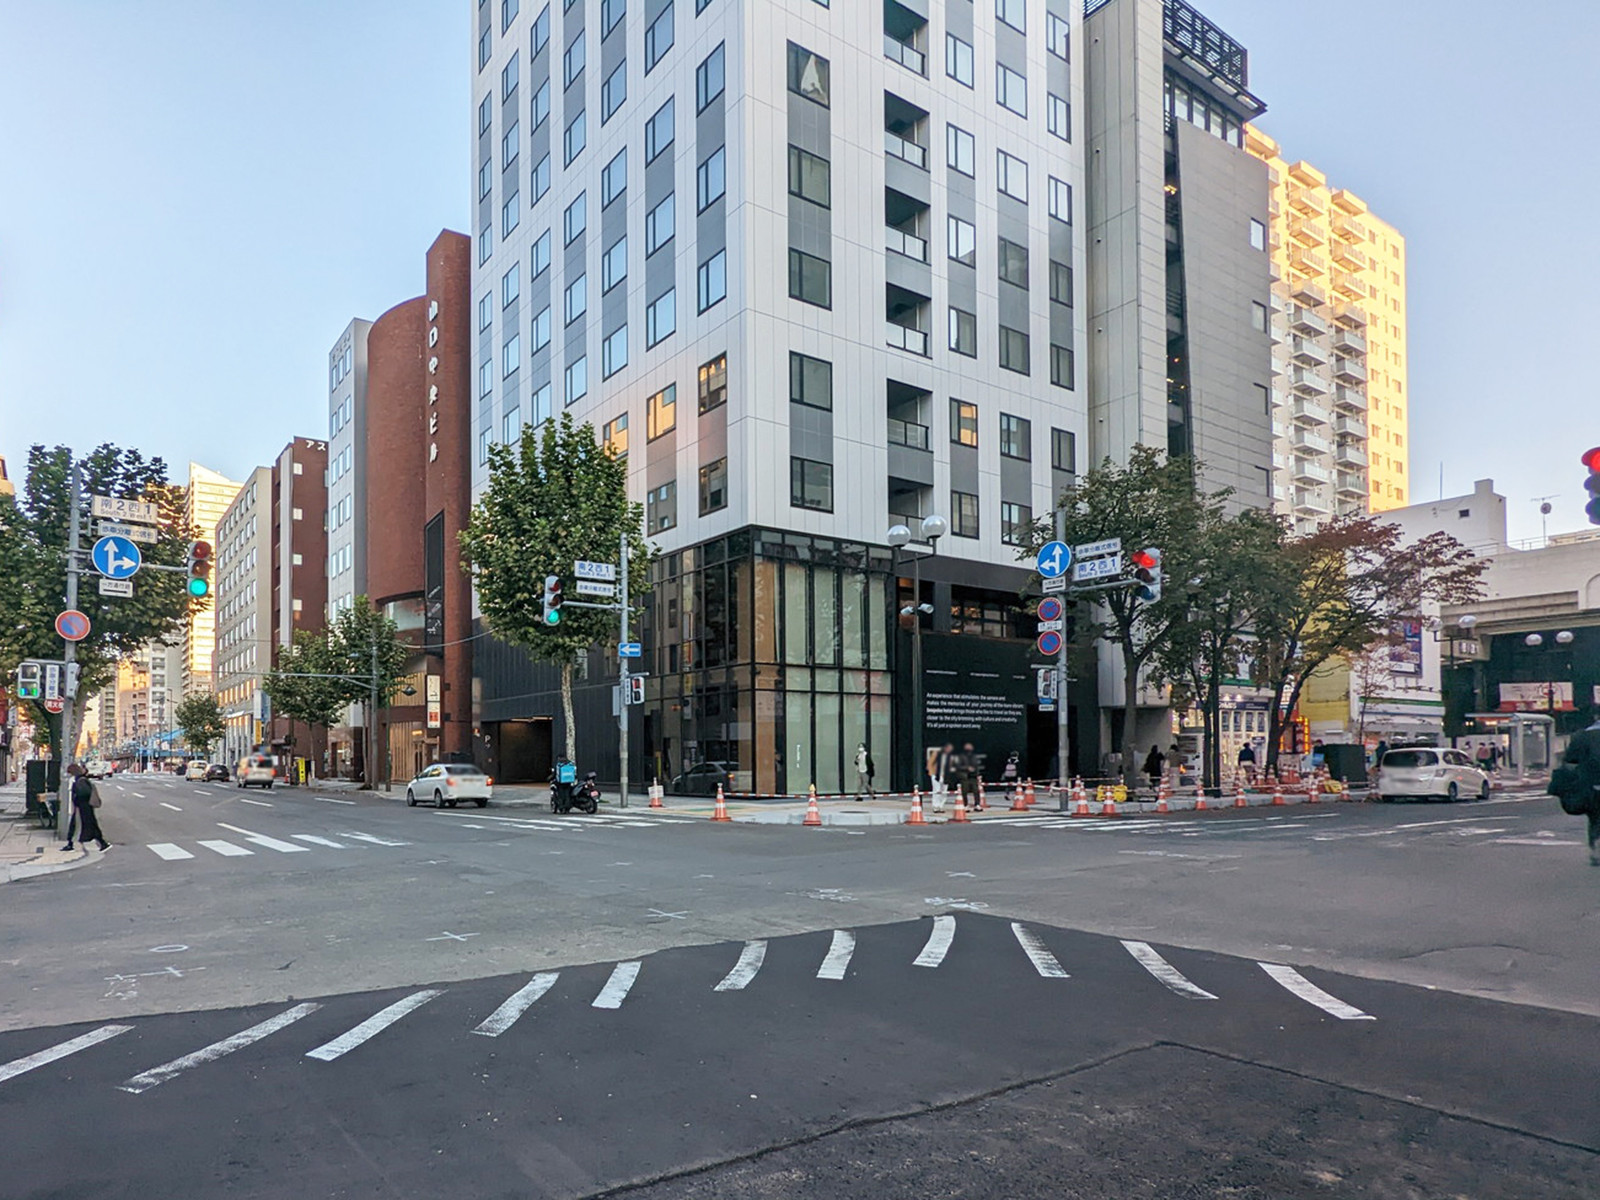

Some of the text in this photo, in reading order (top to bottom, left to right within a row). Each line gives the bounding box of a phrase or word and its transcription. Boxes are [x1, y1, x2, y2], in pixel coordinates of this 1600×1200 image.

[578, 562, 610, 574] 南2西1
[1078, 558, 1116, 572] 南2西1
[485, 734, 491, 743] P
